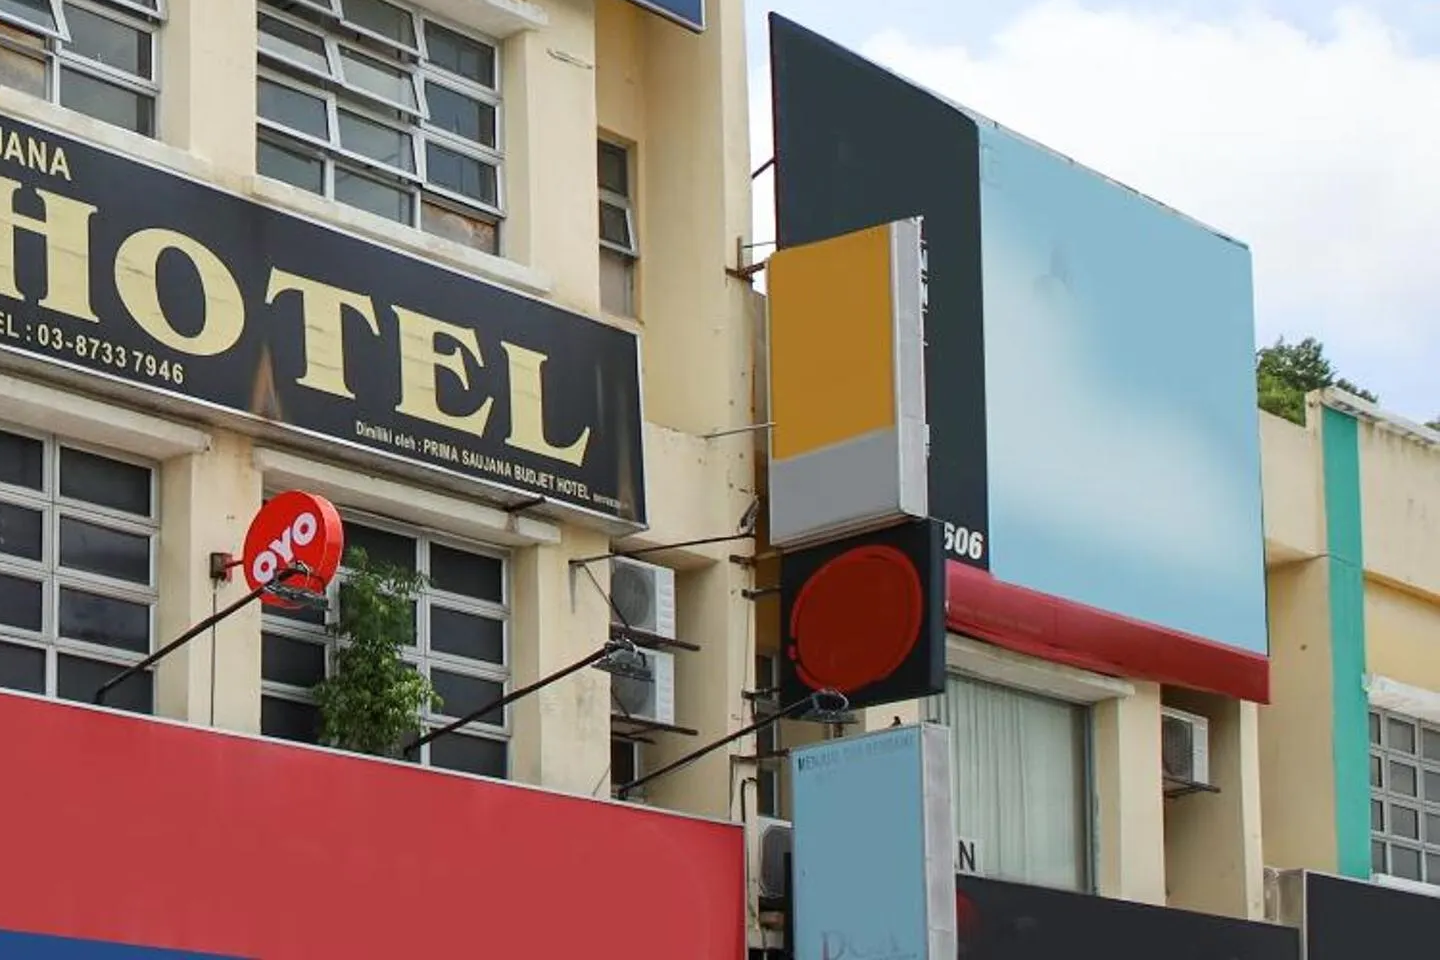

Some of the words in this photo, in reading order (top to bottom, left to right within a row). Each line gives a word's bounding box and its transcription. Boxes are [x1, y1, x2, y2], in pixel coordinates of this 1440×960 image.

[132, 351, 185, 385] 7946
[423, 439, 459, 463] PRIMA
[462, 451, 511, 476] SAUJANA
[514, 465, 555, 489] BUDJET
[557, 476, 591, 500] HOTEL
